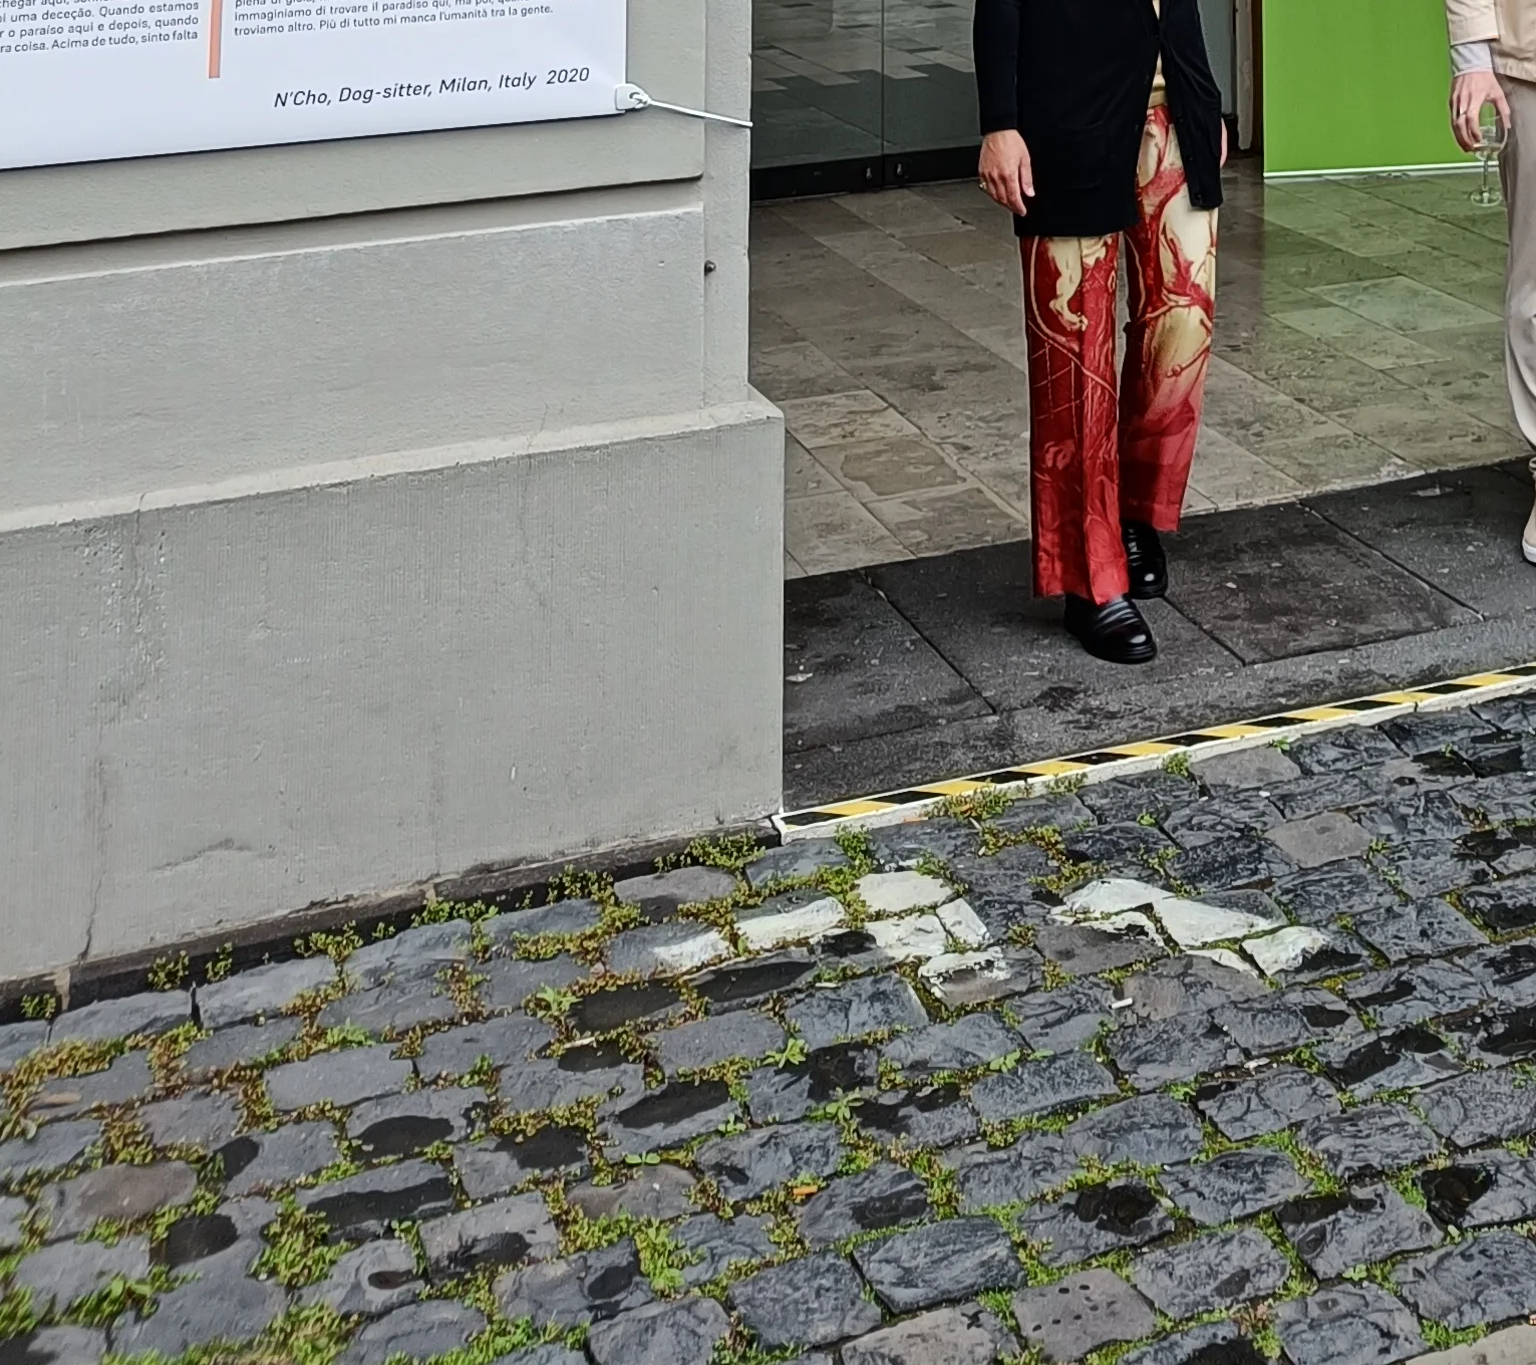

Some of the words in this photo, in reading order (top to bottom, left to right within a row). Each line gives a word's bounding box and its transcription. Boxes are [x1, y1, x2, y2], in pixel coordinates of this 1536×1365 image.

[274, 90, 332, 108] N'Cho,
[338, 82, 432, 104] Dog-sitter,
[439, 77, 492, 94] Milan,
[498, 72, 537, 90] Italy
[546, 67, 590, 85] 2020
